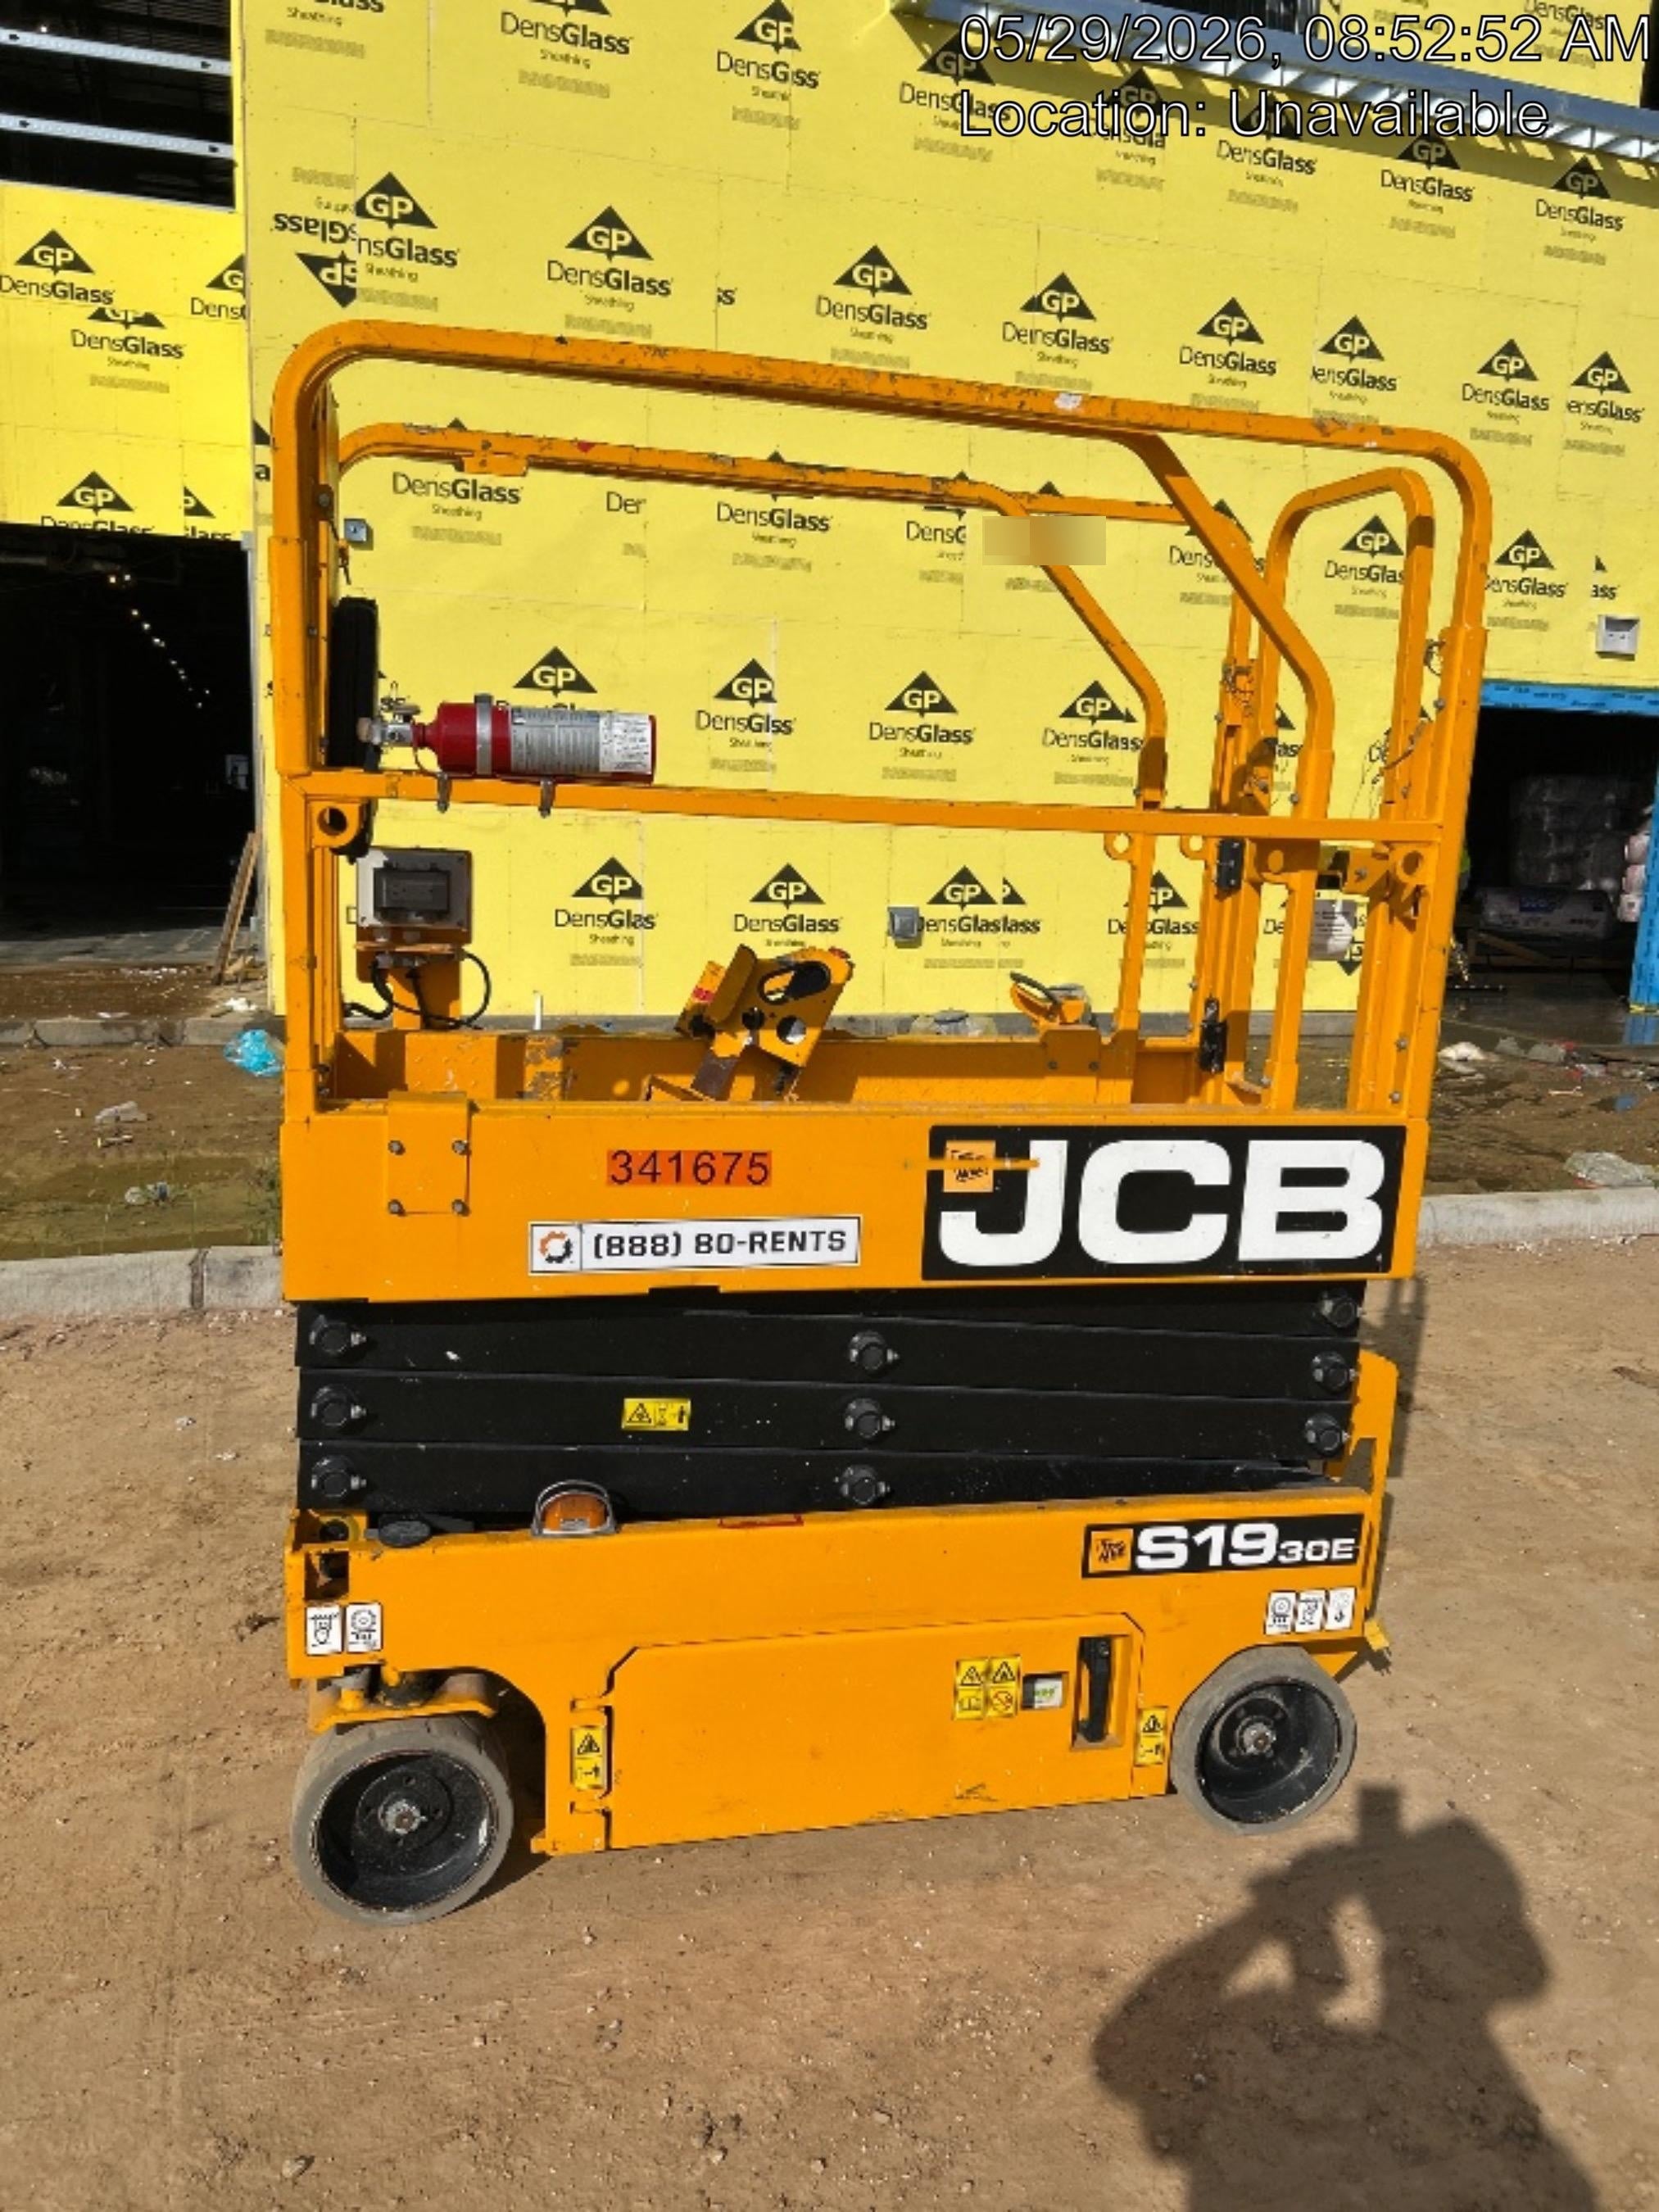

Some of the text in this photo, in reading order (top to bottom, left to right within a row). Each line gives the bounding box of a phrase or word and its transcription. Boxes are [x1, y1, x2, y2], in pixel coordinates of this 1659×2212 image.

[501, 11, 629, 55] DensGlass
[755, 18, 793, 44] GP
[1217, 139, 1317, 175] DensGlass
[1412, 140, 1446, 162] GP
[1381, 170, 1472, 202] DensGlass
[1566, 172, 1598, 193] GP
[365, 194, 413, 219] GP
[1536, 199, 1624, 231] DensGlass
[587, 226, 632, 252] GP
[34, 246, 74, 266] GP
[547, 260, 671, 297] DensGlass
[852, 265, 893, 288] GP
[0, 274, 114, 304] DensGlass
[1041, 290, 1080, 312] GP
[817, 295, 927, 330] DensGlass
[1214, 315, 1249, 337] GP
[71, 329, 183, 358] DensGlass
[1335, 333, 1370, 355] GP
[1180, 346, 1276, 376] DensGlass
[1492, 356, 1525, 374] GP
[1588, 368, 1618, 387] GP
[1462, 383, 1549, 411] DensGlass
[73, 487, 114, 506] GP
[392, 472, 519, 505] DensGlass
[717, 501, 829, 533] DensGlass
[1357, 531, 1389, 551] GP
[1509, 546, 1541, 564] GP
[533, 666, 575, 688] GP
[732, 678, 773, 700] GP
[902, 689, 941, 709] GP
[1076, 698, 1111, 716] GP
[869, 723, 972, 745] DensGlass
[591, 874, 632, 896] GP
[768, 882, 808, 900] GP
[944, 883, 981, 903] GP
[734, 913, 839, 932] DensGlass
[610, 1150, 769, 1185] 341675
[940, 1140, 1385, 1267] JCB
[594, 1231, 682, 1259] (888)
